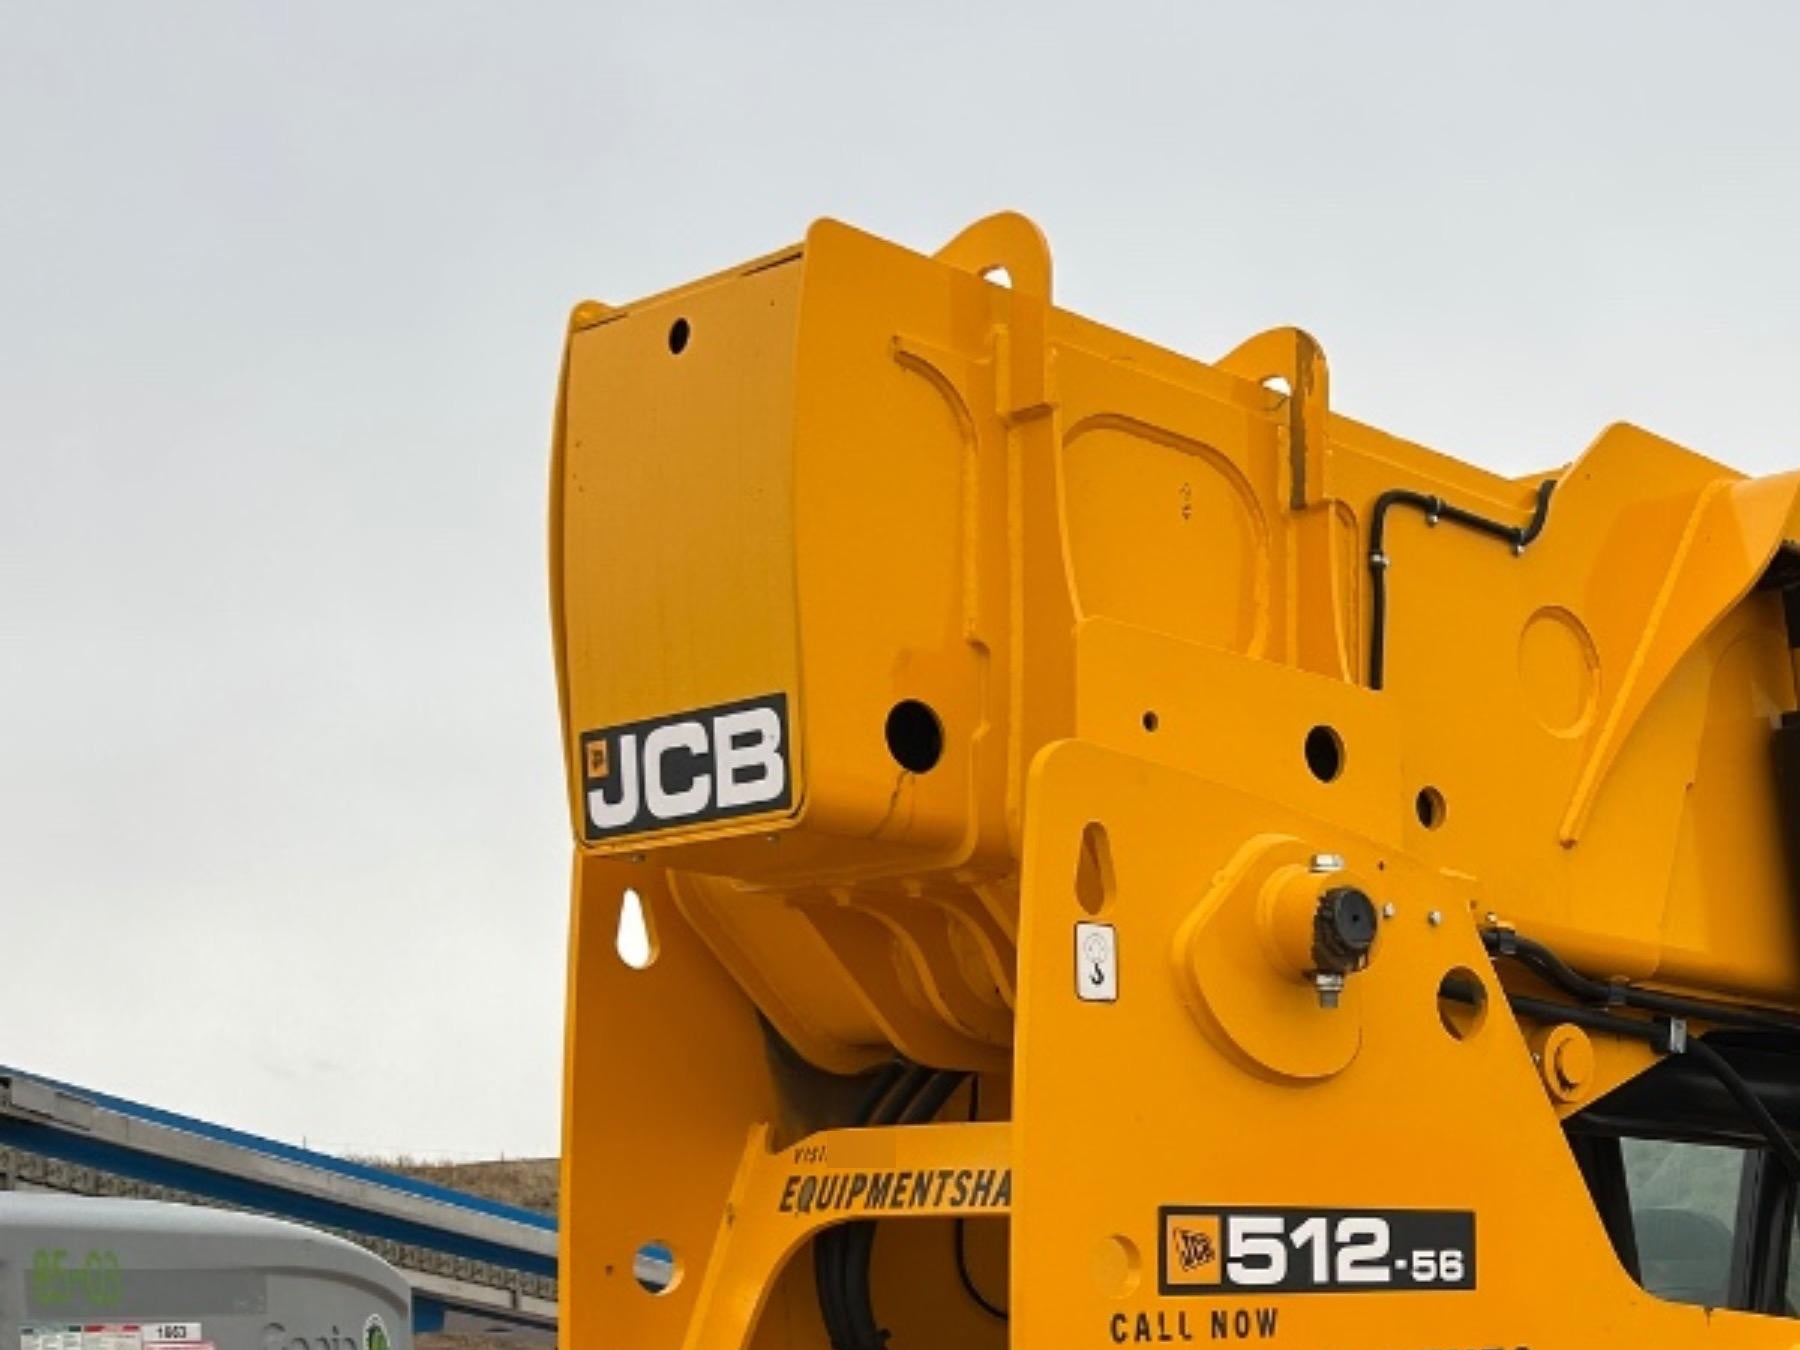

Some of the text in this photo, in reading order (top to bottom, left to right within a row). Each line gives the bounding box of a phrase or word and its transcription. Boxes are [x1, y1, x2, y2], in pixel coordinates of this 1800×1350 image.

[588, 707, 785, 829] JCB
[1109, 1308, 1279, 1344] CALL NOW
